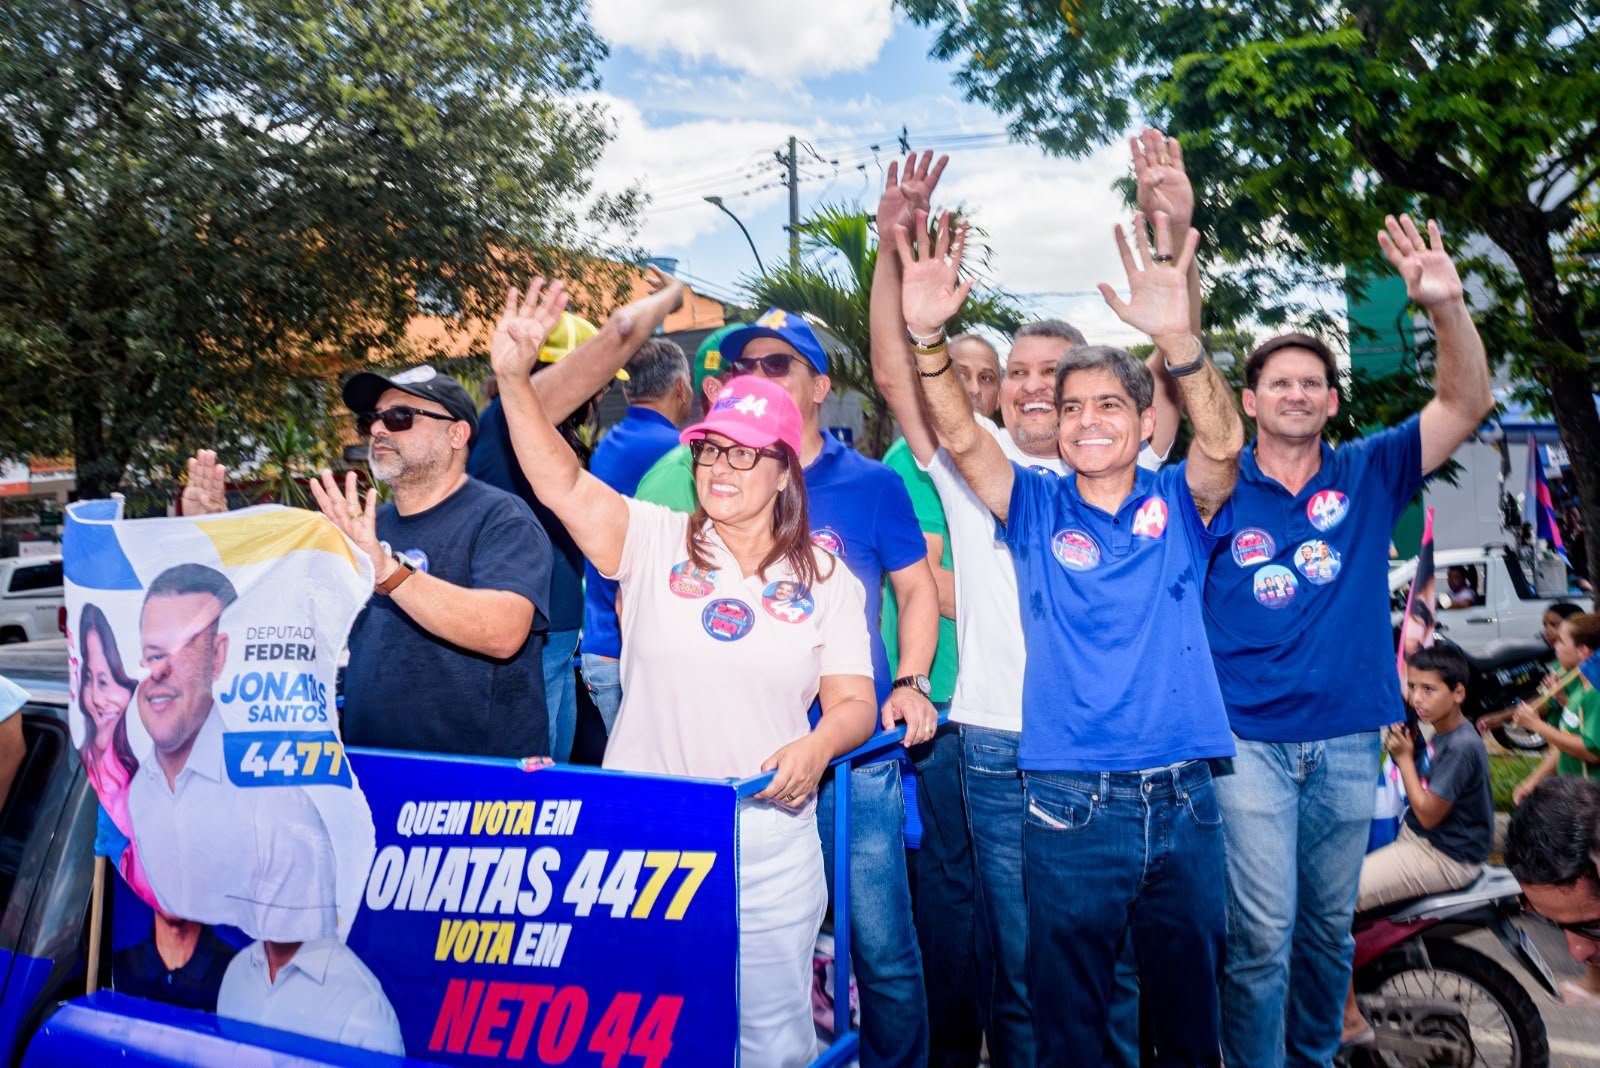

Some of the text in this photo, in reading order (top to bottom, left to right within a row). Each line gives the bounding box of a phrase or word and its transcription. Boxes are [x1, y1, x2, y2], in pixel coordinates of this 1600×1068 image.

[735, 393, 768, 418] 44
[1132, 501, 1165, 536] 44
[1312, 491, 1340, 517] 44
[244, 643, 316, 661] FEDERA
[220, 671, 327, 709] JONATAS
[248, 704, 328, 723] SANTOS
[240, 741, 343, 778] 4477
[397, 799, 582, 838] QUEM VOTA EM
[366, 846, 717, 920] ONATAS 4477
[434, 919, 572, 968] VOTA EM
[428, 978, 685, 1068] NETO 44
